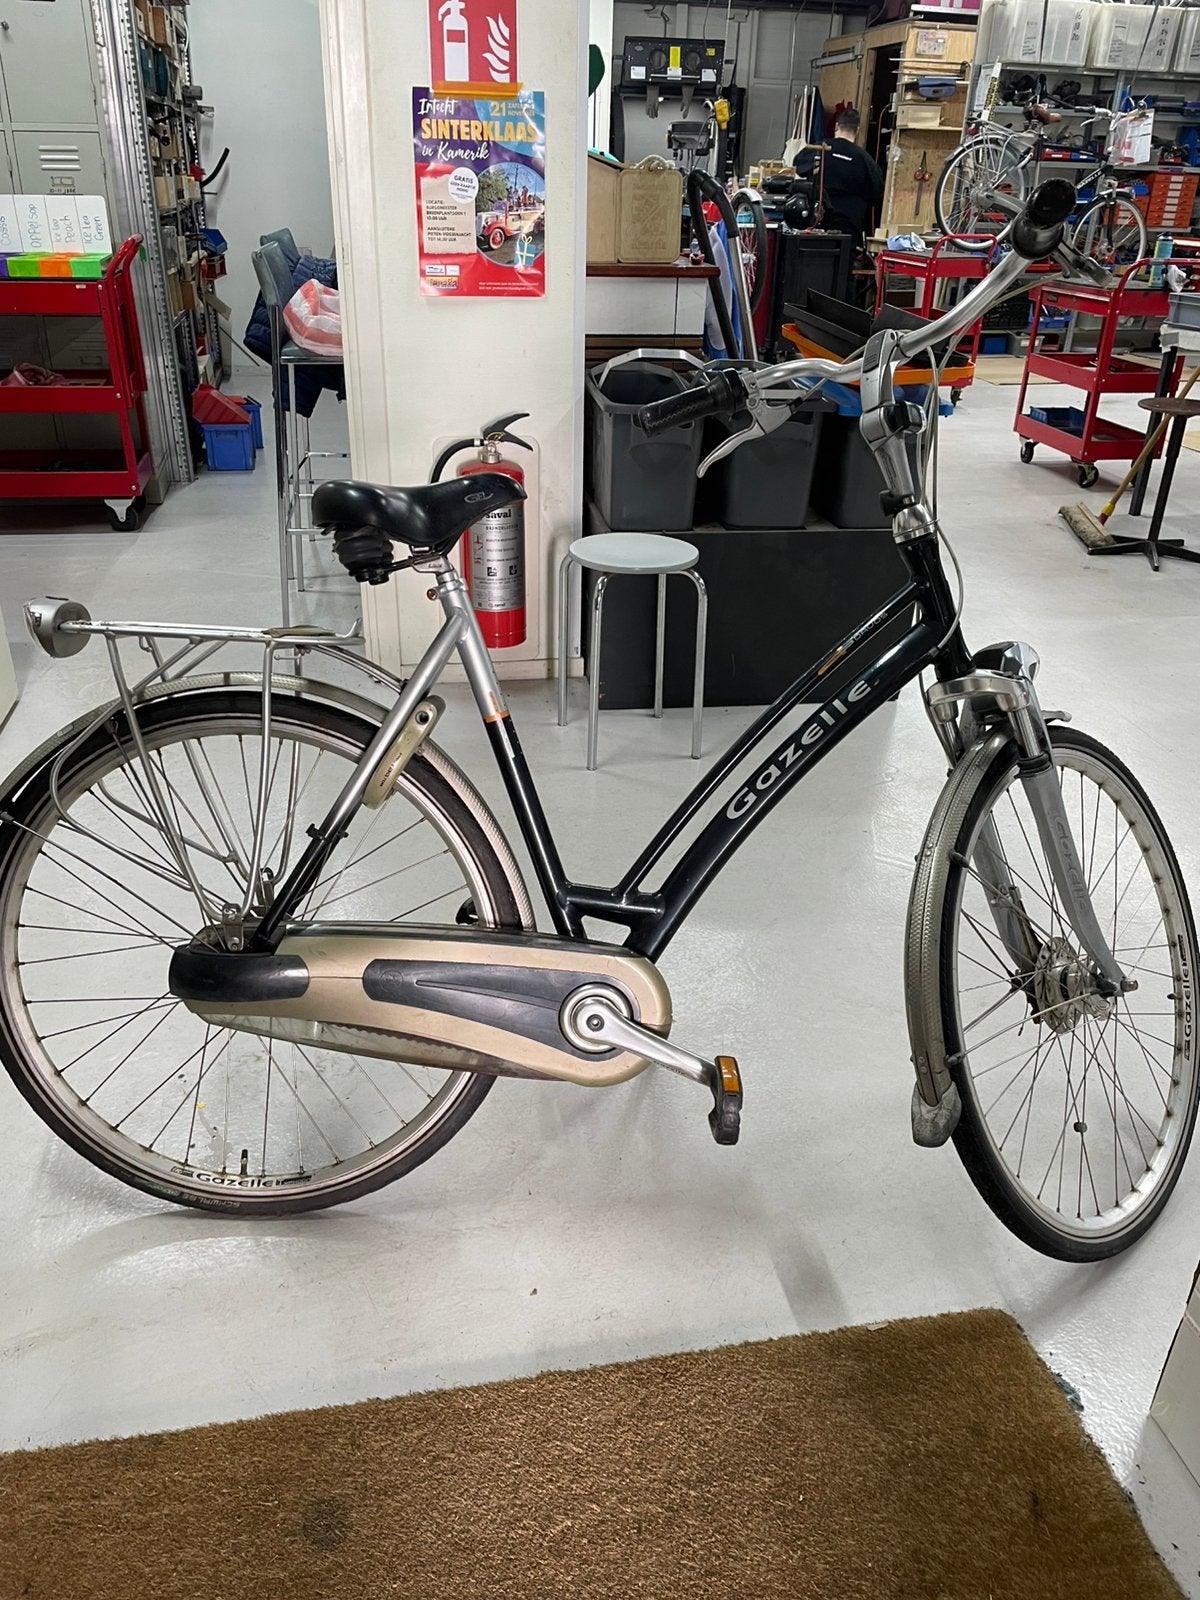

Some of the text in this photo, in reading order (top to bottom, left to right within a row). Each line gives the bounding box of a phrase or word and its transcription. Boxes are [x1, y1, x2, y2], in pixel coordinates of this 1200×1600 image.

[417, 97, 458, 115] Intocht
[490, 102, 506, 117] 21
[421, 118, 538, 143] SINTERKLAAS
[422, 141, 490, 161] in Kamerik
[454, 174, 474, 184] GRATIS
[93, 216, 104, 241] Green
[726, 680, 872, 820] Gazelle
[1182, 965, 1193, 1038] Gazelle
[195, 1172, 274, 1188] Gazelle
